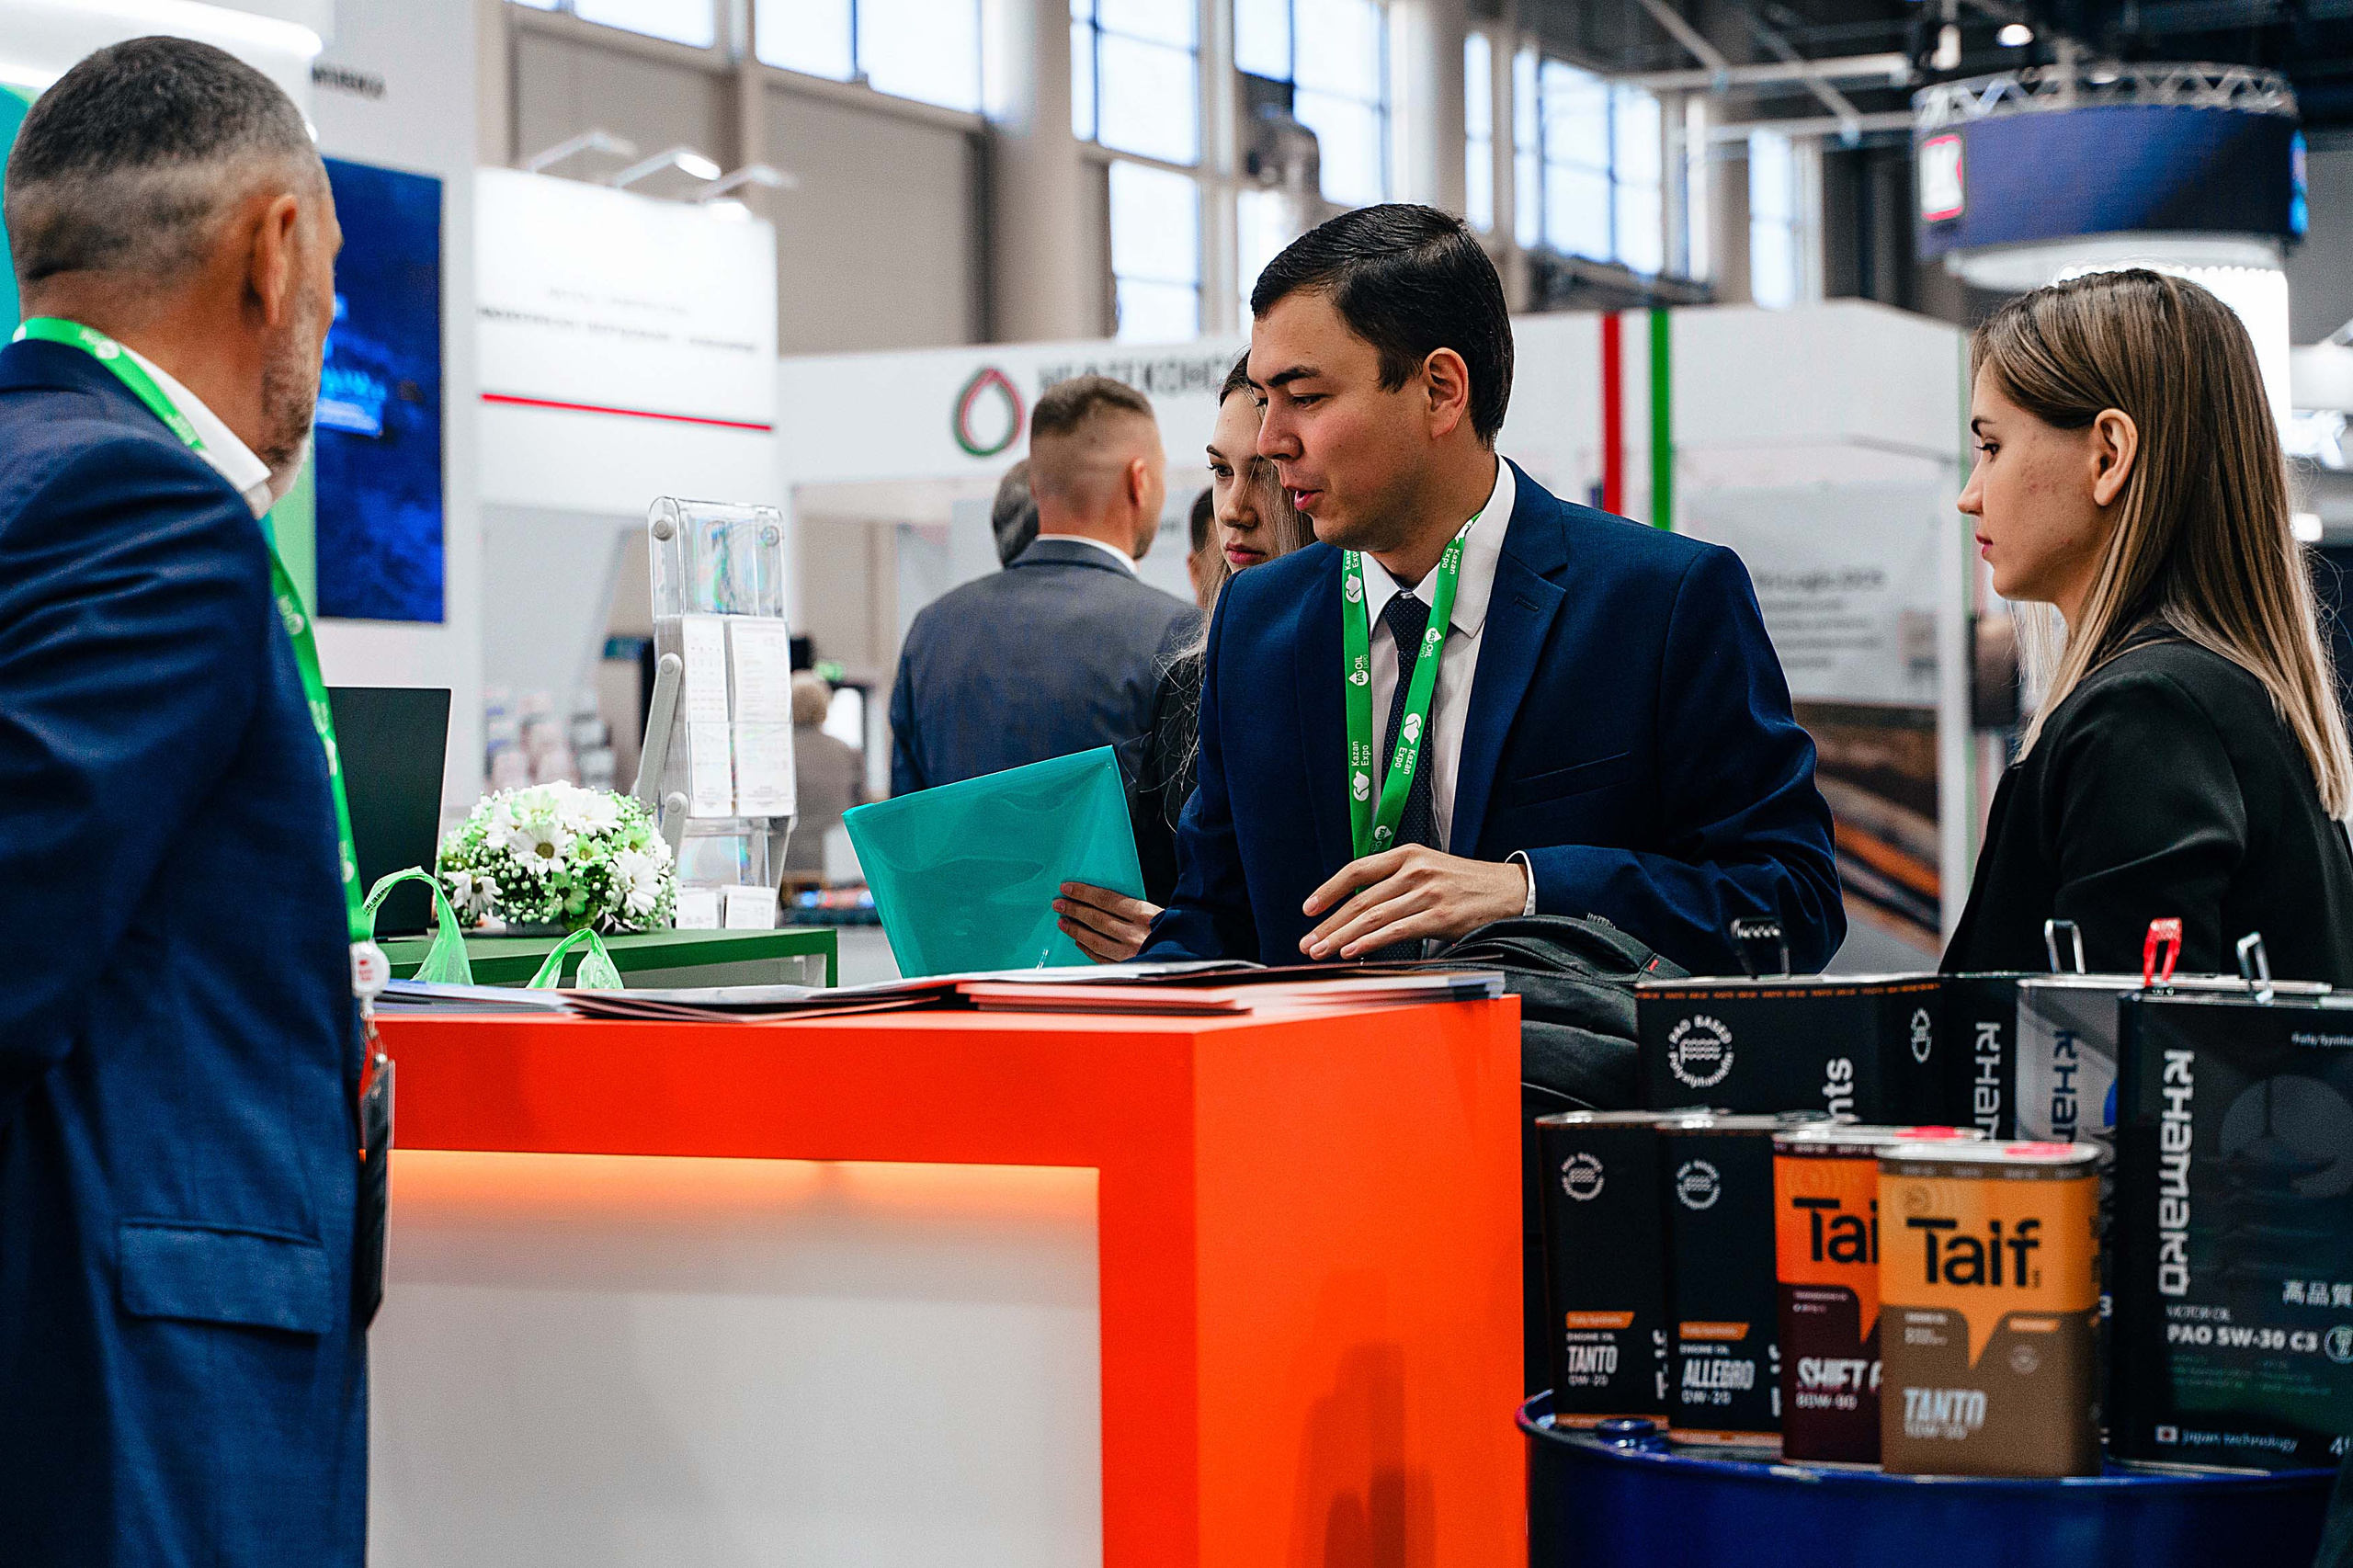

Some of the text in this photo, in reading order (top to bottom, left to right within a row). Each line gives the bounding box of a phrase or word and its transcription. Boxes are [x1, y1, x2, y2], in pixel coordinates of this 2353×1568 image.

[1442, 548, 1453, 569] Expo
[1449, 549, 1460, 574] Kazan
[1355, 655, 1363, 670] OIL
[1424, 644, 1434, 658] OIL
[1351, 741, 1359, 767] Kazan
[1360, 744, 1371, 767] Expo
[1394, 746, 1408, 768] Expo
[1403, 748, 1416, 775] Kazan
[1906, 1219, 2041, 1288] Taif
[2166, 1324, 2212, 1346] PAO
[2290, 1331, 2318, 1353] C3
[1566, 1345, 1618, 1375] TANTO
[1681, 1358, 1756, 1392] ALLEGRO
[1903, 1387, 1988, 1430] TANTO
